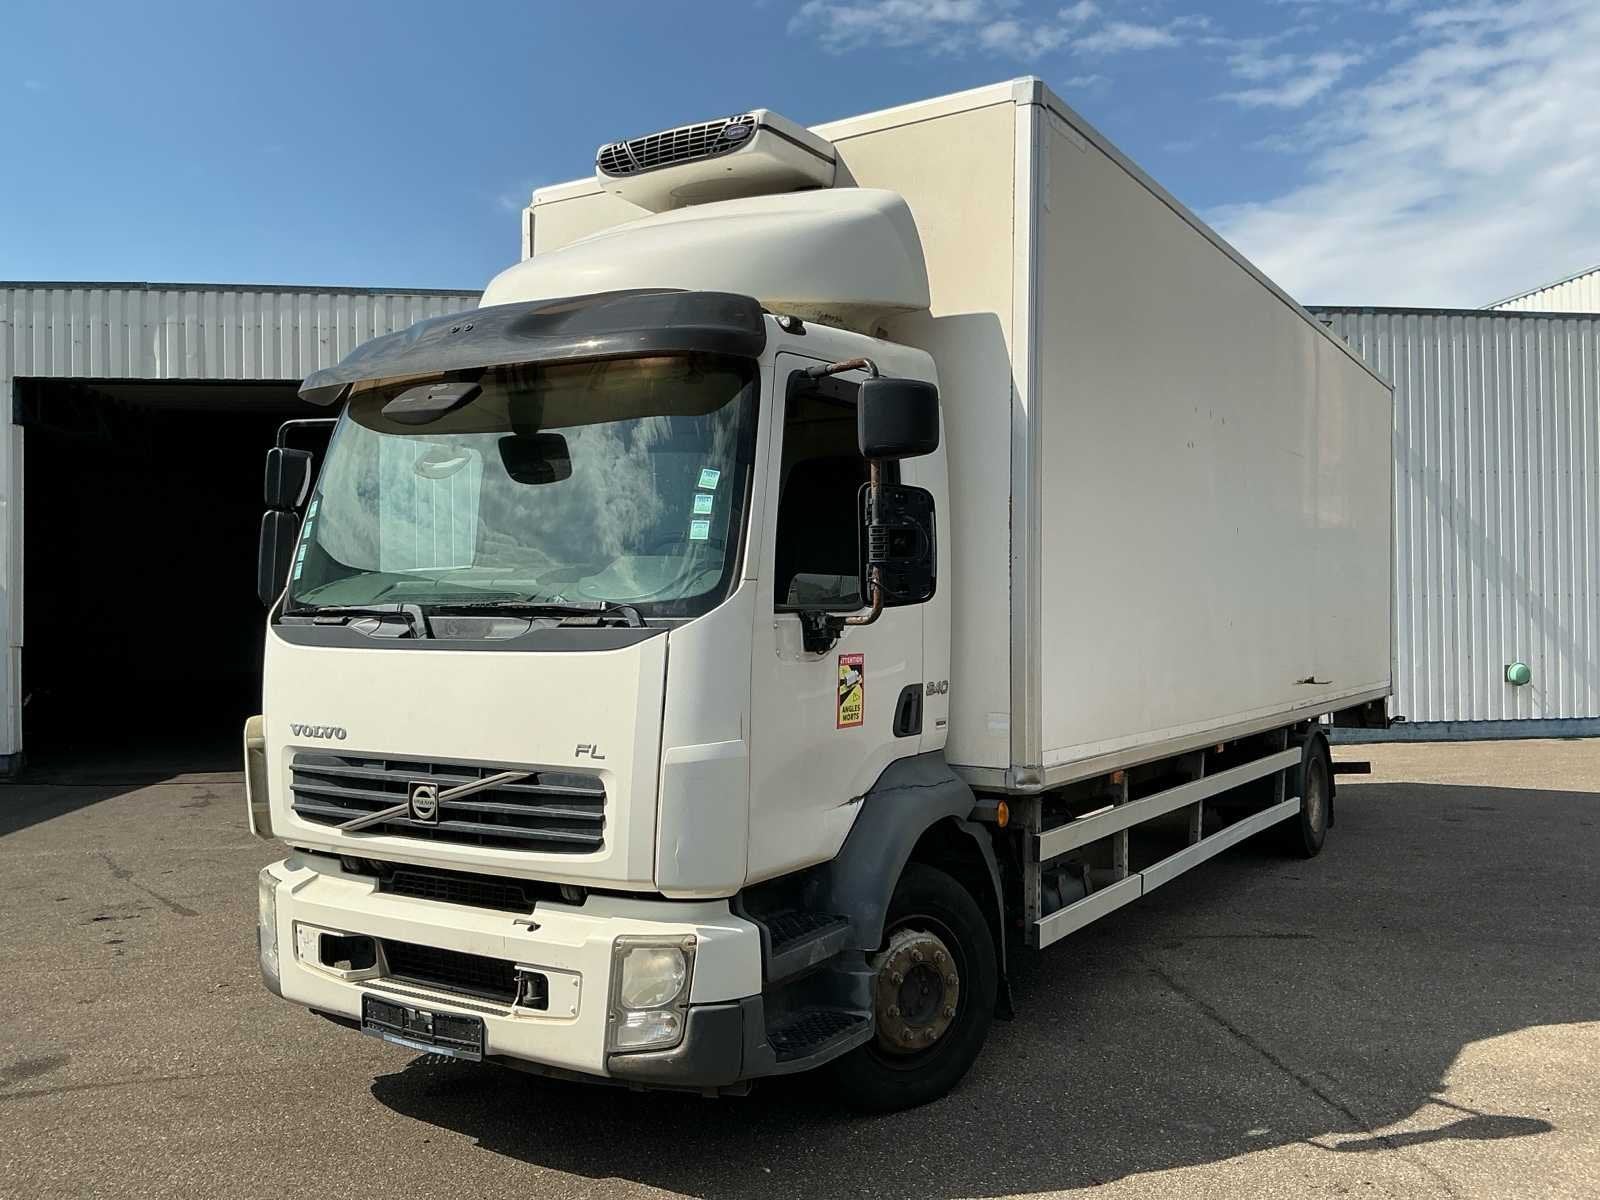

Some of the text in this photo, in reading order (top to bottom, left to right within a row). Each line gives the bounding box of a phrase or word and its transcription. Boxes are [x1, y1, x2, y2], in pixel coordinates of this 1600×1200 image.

[842, 705, 861, 713] ANGLES
[842, 713, 860, 721] MORTS
[289, 724, 347, 740] VOLVO
[575, 744, 605, 760] FL
